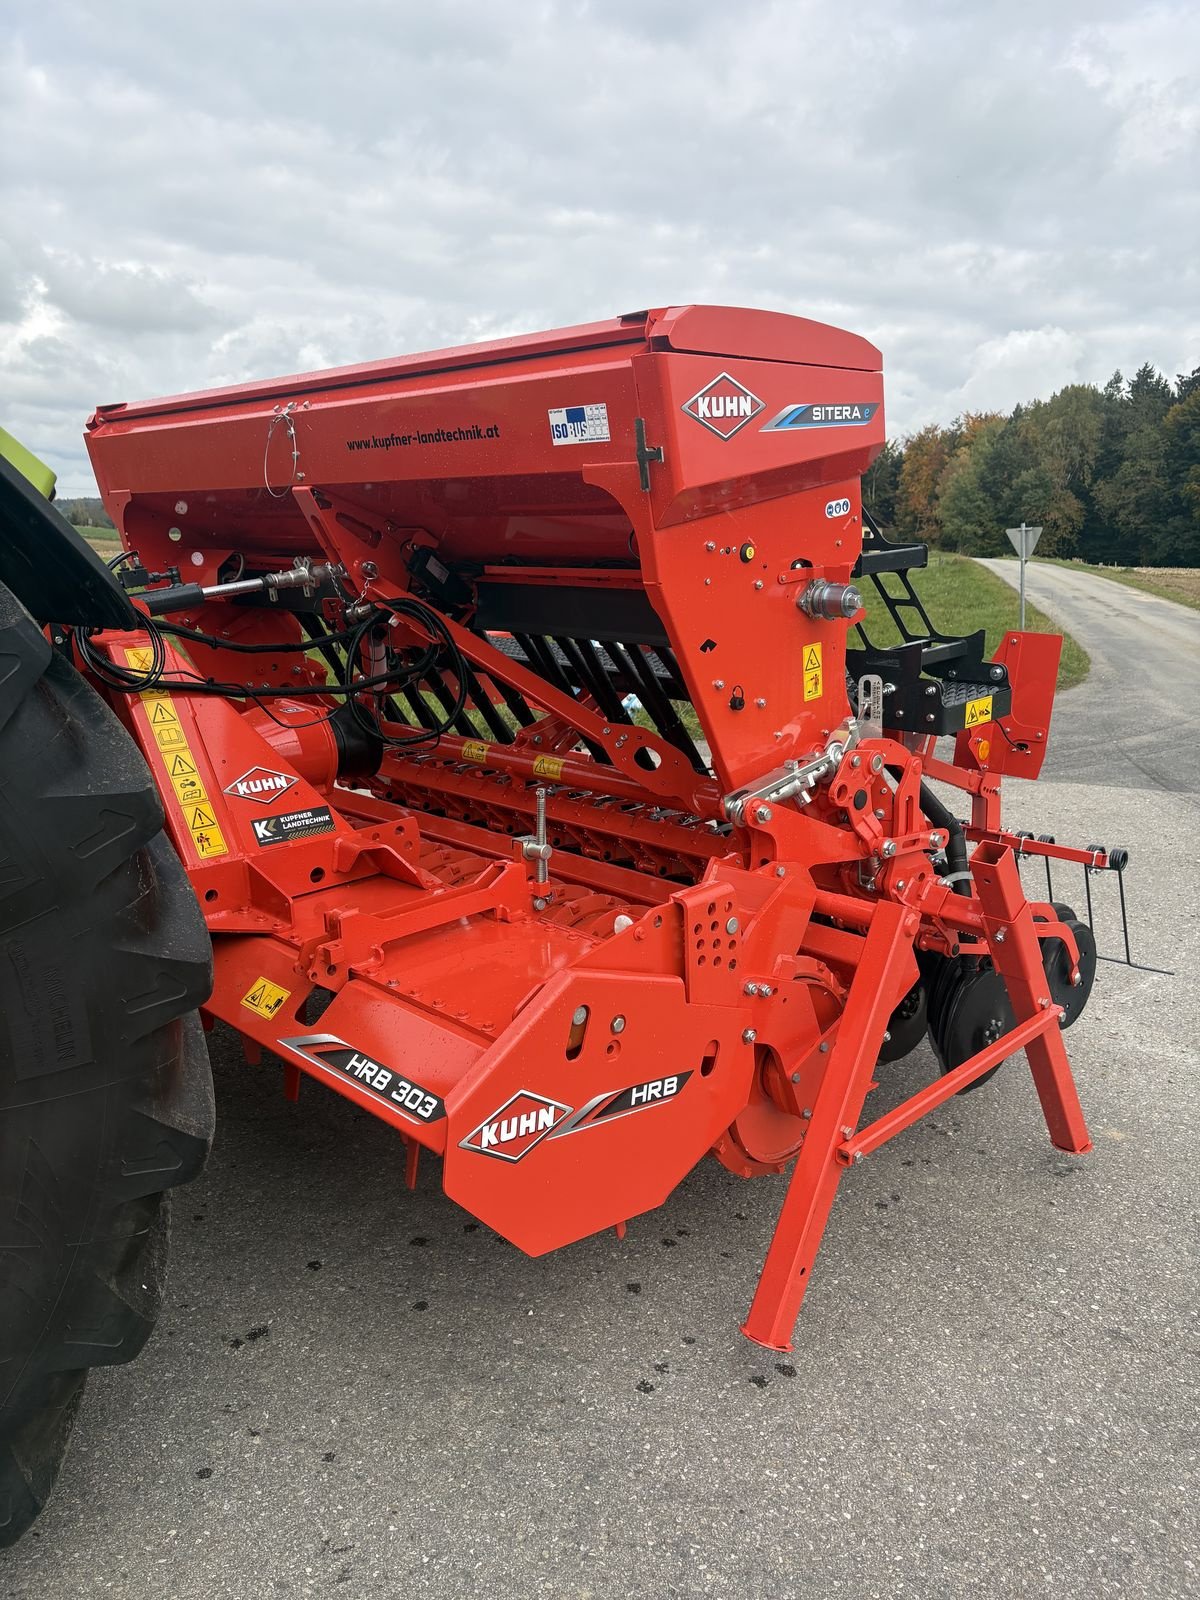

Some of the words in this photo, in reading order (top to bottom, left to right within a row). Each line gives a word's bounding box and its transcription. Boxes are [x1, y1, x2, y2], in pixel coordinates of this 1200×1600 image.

[697, 395, 752, 418] KUHN
[812, 406, 861, 421] SITERA
[347, 425, 500, 451] www.kupfner-landtechnik.at
[551, 421, 588, 439] ISOBUS
[237, 776, 288, 795] KUHN
[280, 811, 313, 823] KUPFNER
[282, 815, 331, 830] LANDTECHNIK
[42, 967, 75, 1062] MICHELIN
[345, 1053, 392, 1091] HRB
[391, 1080, 438, 1118] 303
[631, 1076, 678, 1106] HRB
[480, 1105, 555, 1149] KUHN
